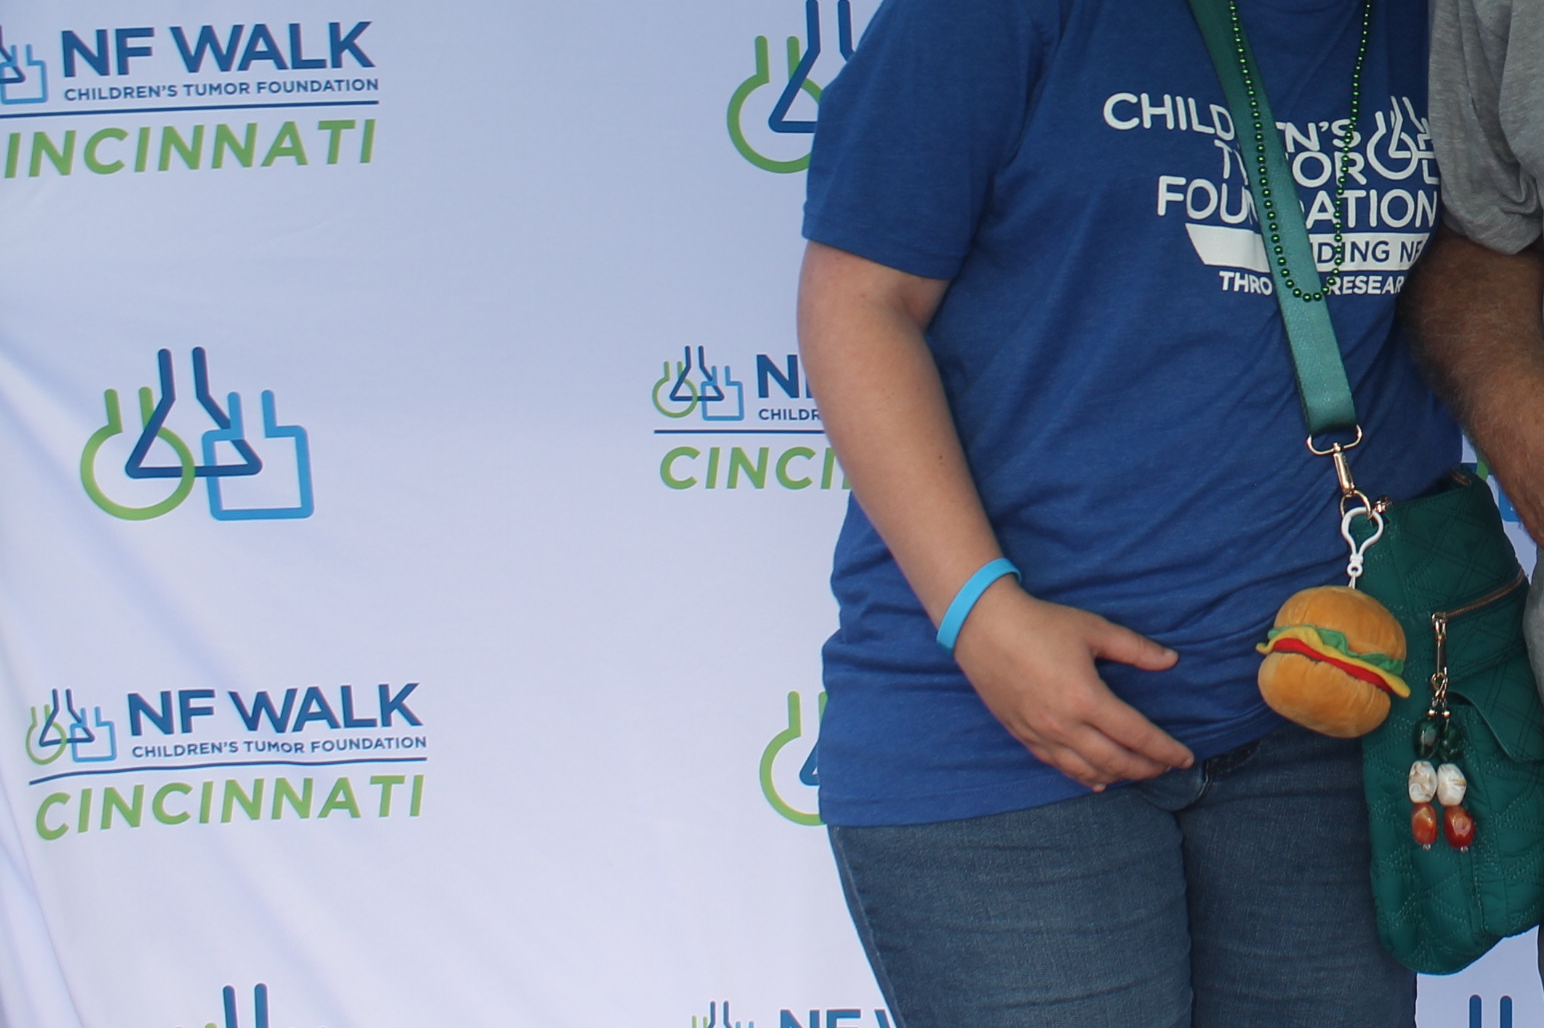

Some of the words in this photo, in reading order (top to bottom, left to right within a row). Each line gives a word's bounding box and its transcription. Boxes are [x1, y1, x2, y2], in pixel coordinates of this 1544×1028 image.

[61, 26, 155, 78] NF
[169, 21, 376, 73] WALK
[63, 84, 178, 102] CHILDREN'S
[182, 81, 251, 97] TUMOR
[256, 78, 379, 95] FOUNDATION
[1103, 92, 1362, 149] CHILDN'S
[4, 118, 376, 179] INCINNATI
[1213, 138, 1368, 189] TOR
[1157, 175, 1438, 229] FOUATION
[1219, 270, 1273, 296] THRO
[756, 354, 815, 399] N
[128, 689, 216, 737] NF
[228, 682, 424, 734] WALK
[132, 741, 240, 759] CHILDREN'S
[243, 740, 306, 754] TUMOR
[311, 736, 428, 753] FOUNDATION
[35, 774, 424, 841] CINCINNATI
